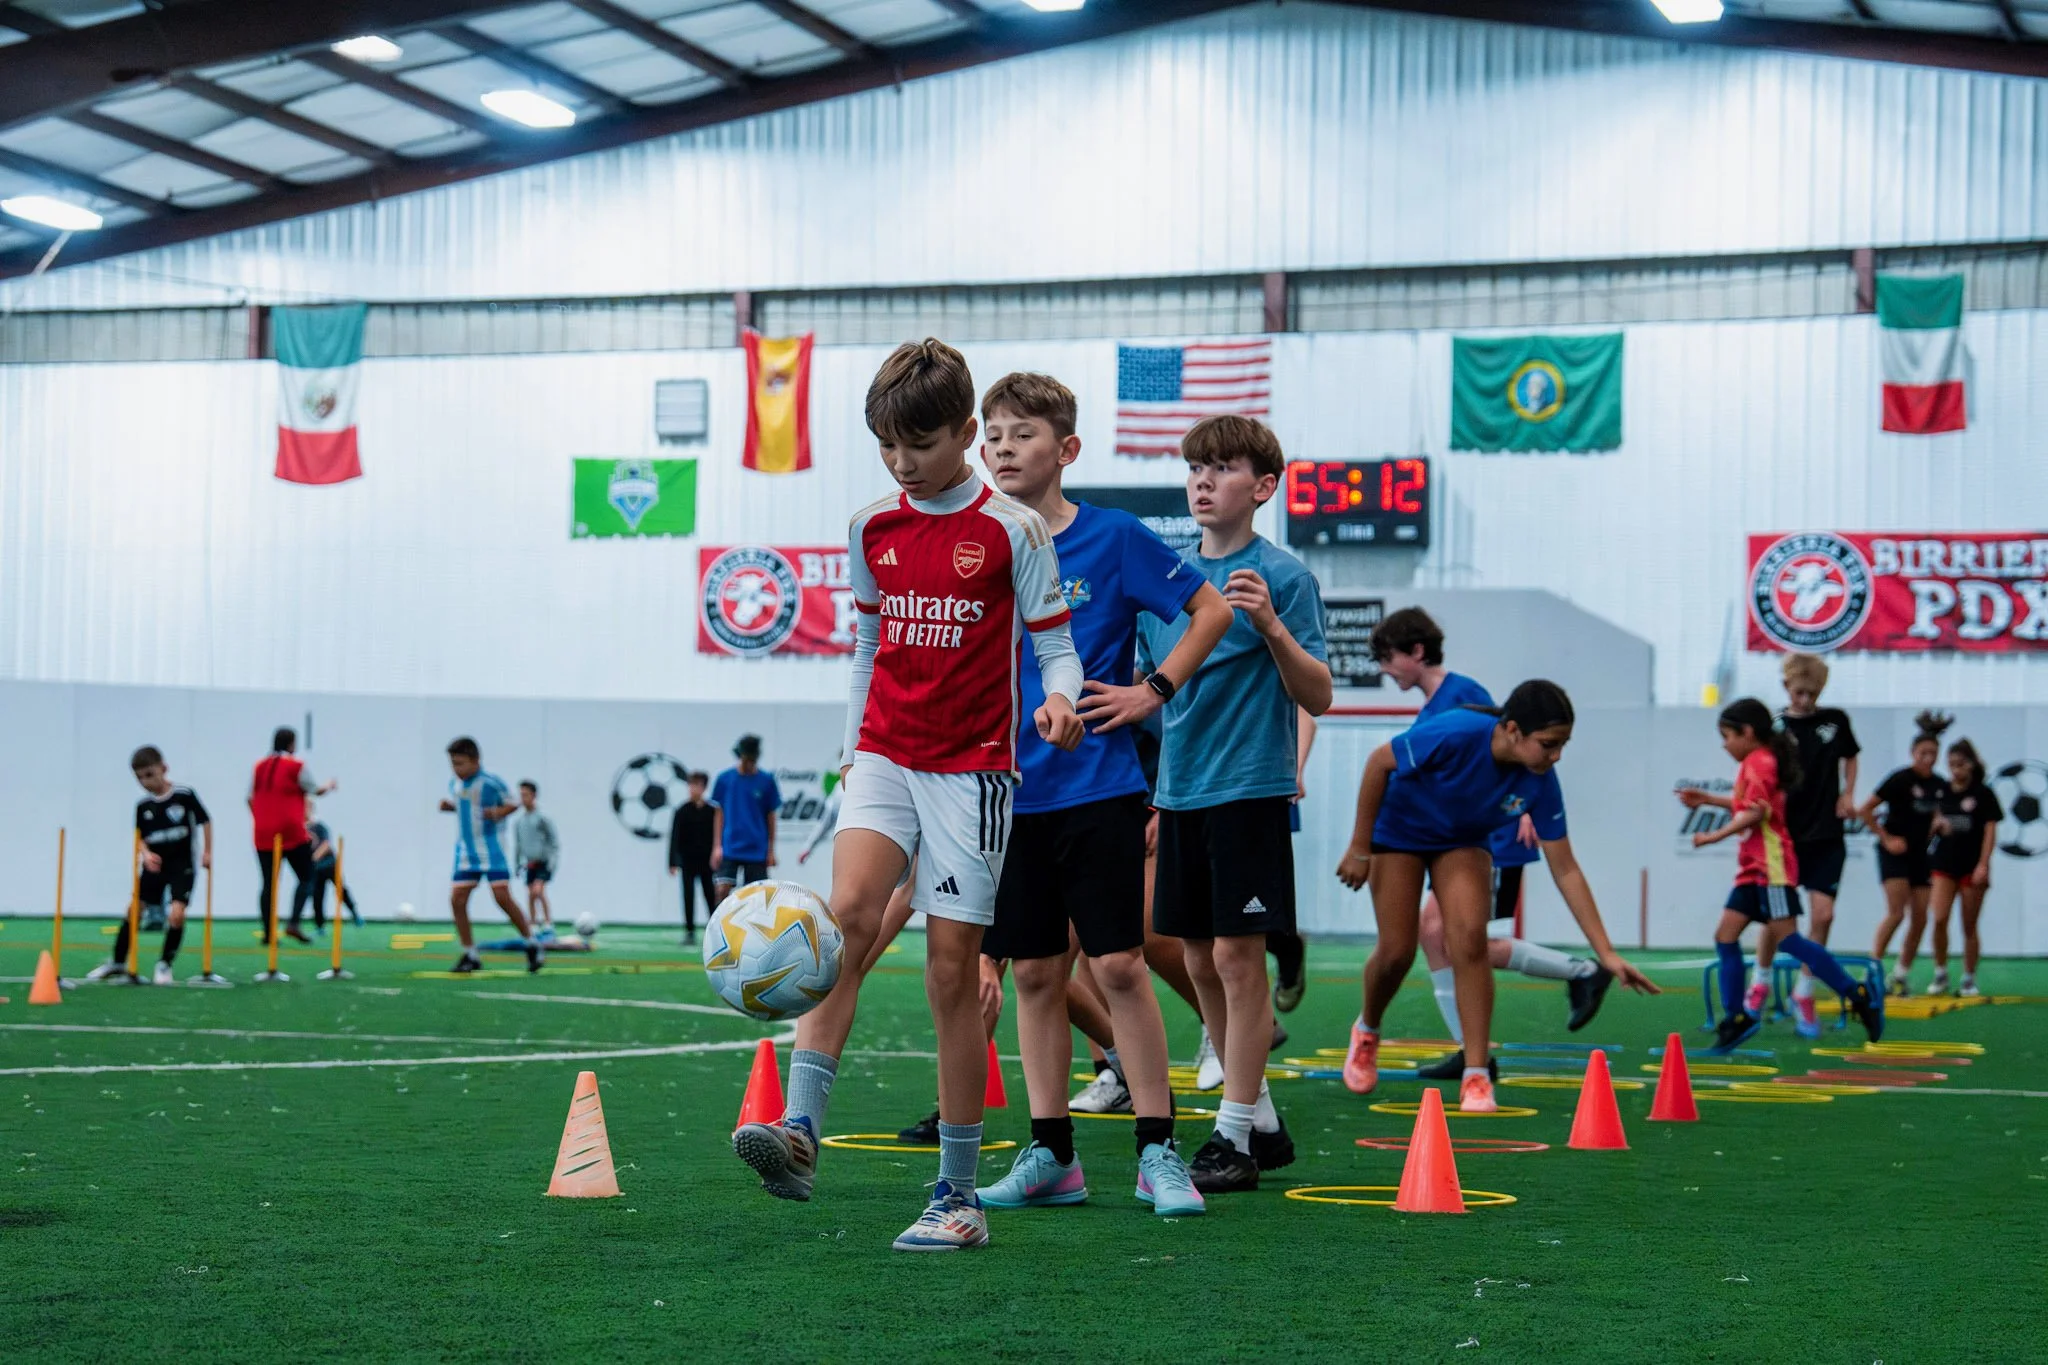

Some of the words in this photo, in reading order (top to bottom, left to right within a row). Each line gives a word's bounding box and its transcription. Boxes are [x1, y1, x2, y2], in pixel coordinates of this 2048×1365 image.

[1287, 459, 1425, 515] 65:12
[878, 589, 985, 623] Emirates
[887, 620, 905, 645] FLY
[905, 622, 963, 649] BETTER
